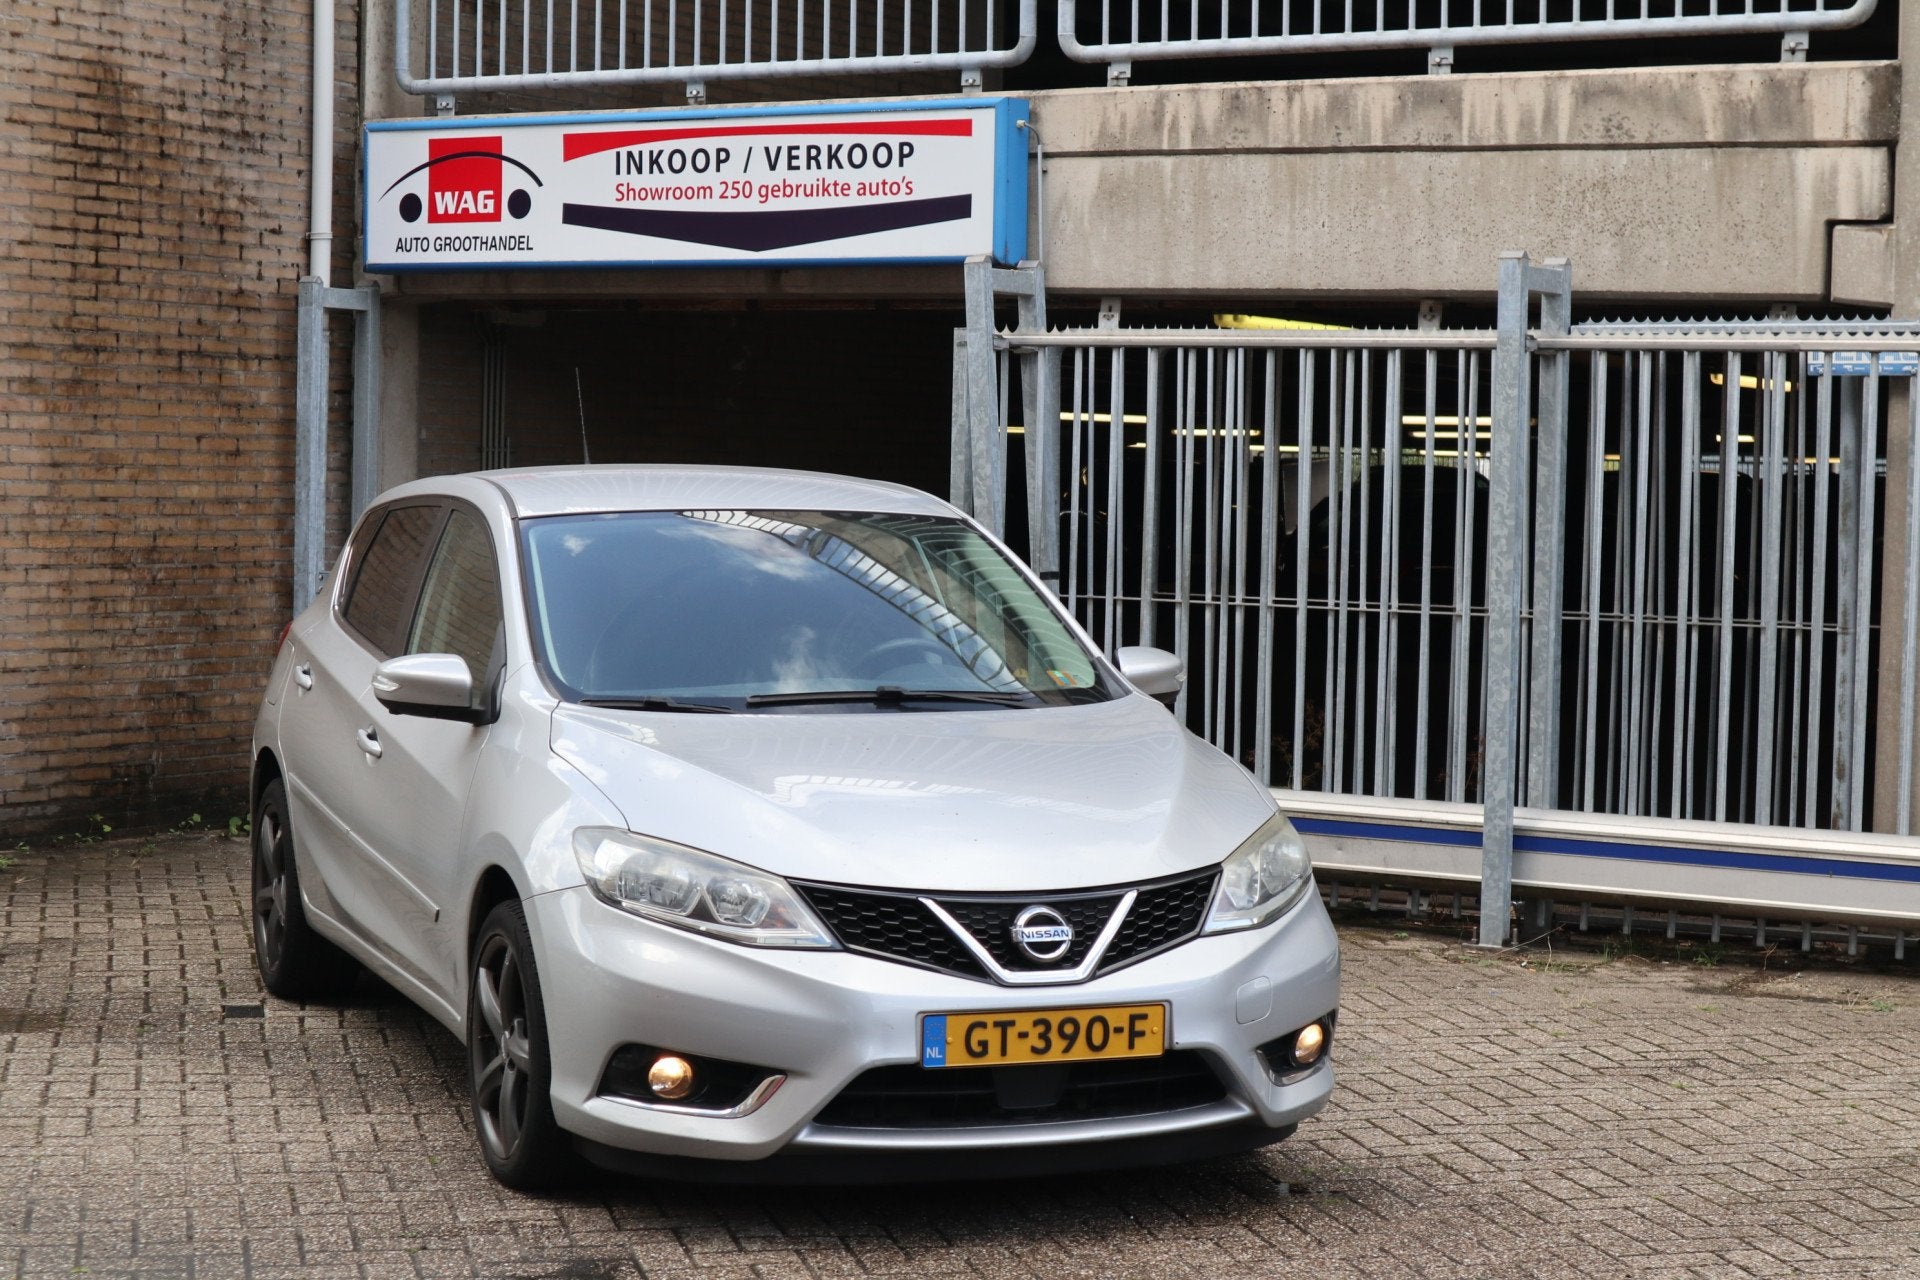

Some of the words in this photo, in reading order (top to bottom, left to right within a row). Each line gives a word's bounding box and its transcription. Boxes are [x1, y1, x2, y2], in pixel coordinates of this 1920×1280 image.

[615, 147, 731, 176] INKOOP
[742, 146, 753, 174] /
[764, 141, 915, 172] VERKOOP
[434, 189, 495, 216] WAG
[615, 182, 713, 202] Showroom
[719, 180, 753, 200] 250
[757, 178, 851, 204] gebruikte
[395, 236, 430, 253] AUTO
[433, 235, 534, 253] GROOTHANDEL
[1020, 929, 1070, 940] NISSAN
[964, 1013, 1149, 1058] GT-390-F
[926, 1046, 943, 1060] NL
